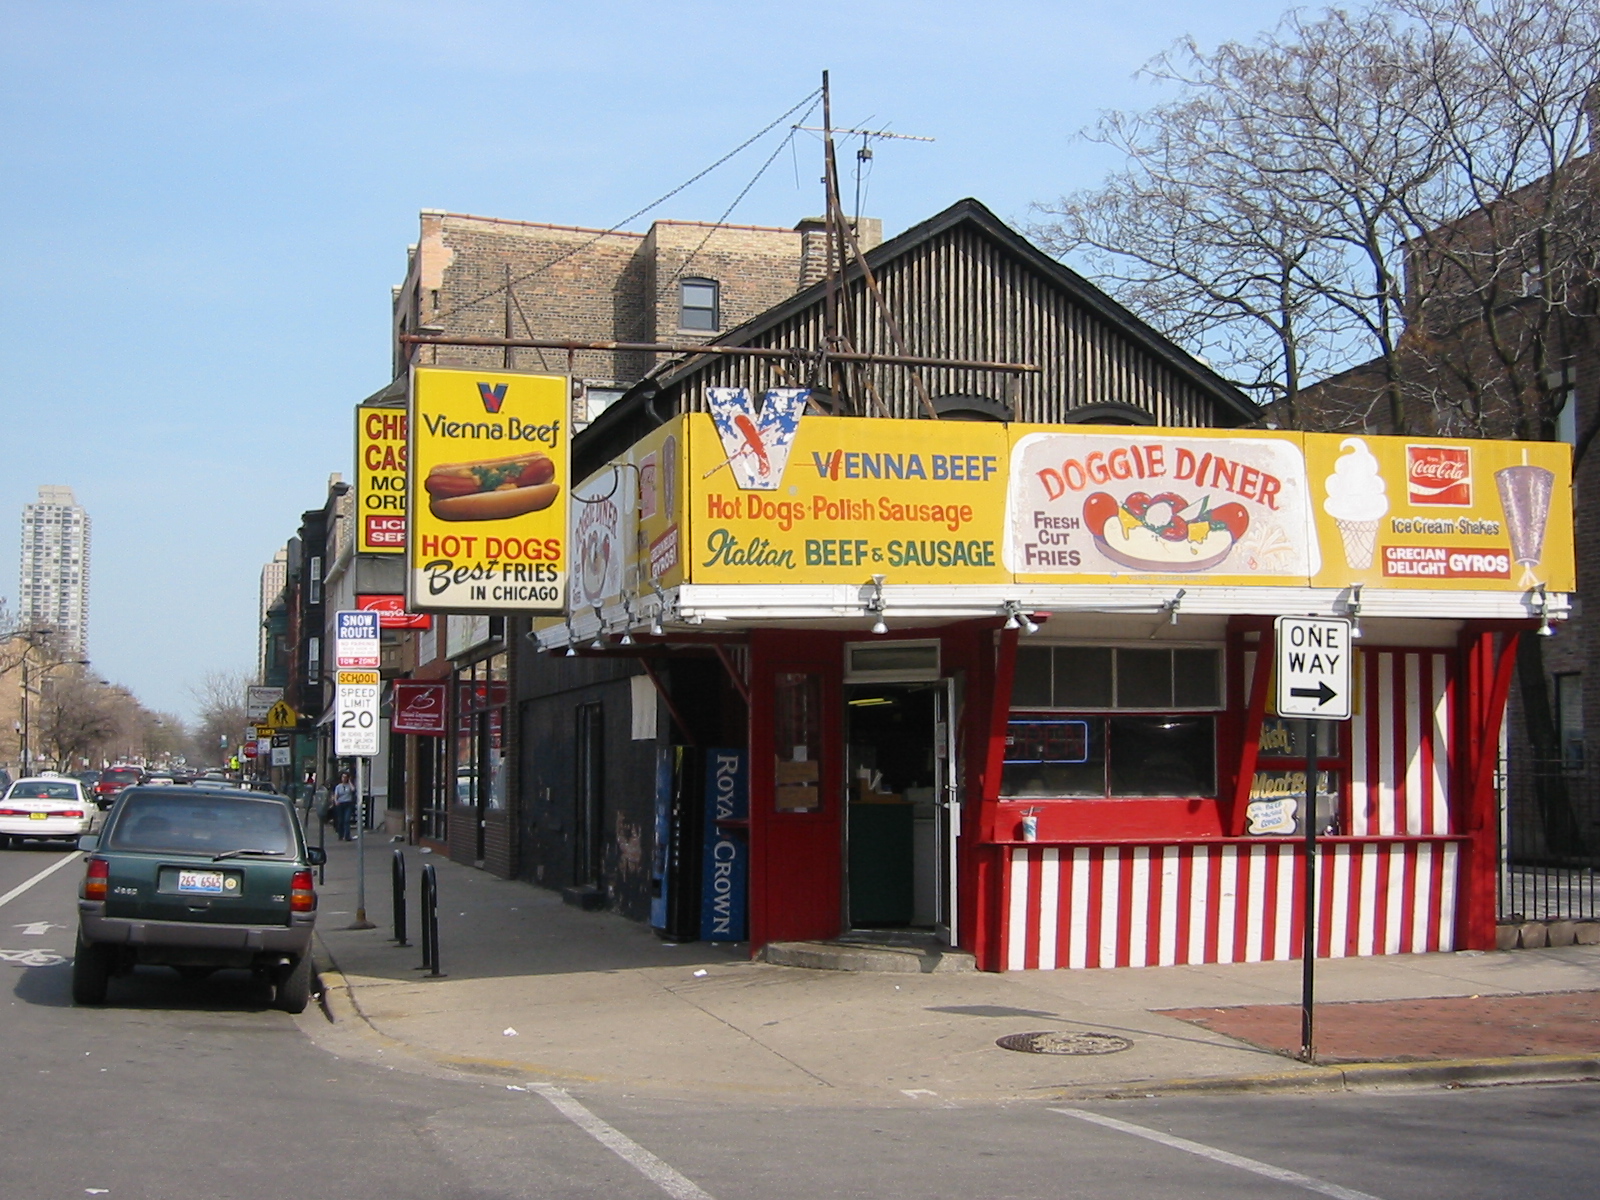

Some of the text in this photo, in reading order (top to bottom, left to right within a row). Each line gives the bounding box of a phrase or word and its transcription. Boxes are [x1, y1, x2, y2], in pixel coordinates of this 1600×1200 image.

[422, 413, 560, 449] Vienna Beef
[812, 449, 998, 481] VIENNA BEEF
[1412, 459, 1466, 479] Coca-Cola
[1035, 444, 1281, 511] DOGGIE DINER
[707, 493, 973, 531] Hot Dogs Polish Sausage
[1034, 511, 1080, 530] FRESH
[1391, 516, 1499, 535] Ice Cream Shakes
[422, 534, 560, 560] HOT DOGS
[1038, 529, 1070, 546] CUT
[702, 529, 796, 569] Italian
[805, 539, 869, 566] BEEF
[871, 547, 884, 561] &
[888, 540, 996, 567] SAUSAGE
[1025, 543, 1081, 566] FRIES
[1386, 547, 1446, 560] GRECIAN
[1387, 561, 1447, 575] DELIGHT
[1449, 554, 1509, 573] GYROS
[423, 559, 558, 595] Best FRIES
[470, 586, 558, 601] IN CHICAGO
[343, 615, 373, 626] SNOW
[340, 627, 375, 638] ROUTE
[1291, 626, 1338, 648] ONE
[1289, 652, 1340, 674] WAY
[340, 674, 375, 683] SCHOOL
[341, 688, 375, 697] SPEED
[344, 699, 371, 707] LIMIT
[342, 710, 373, 728] 20
[181, 875, 196, 887] 265
[712, 841, 737, 935] CROWN
